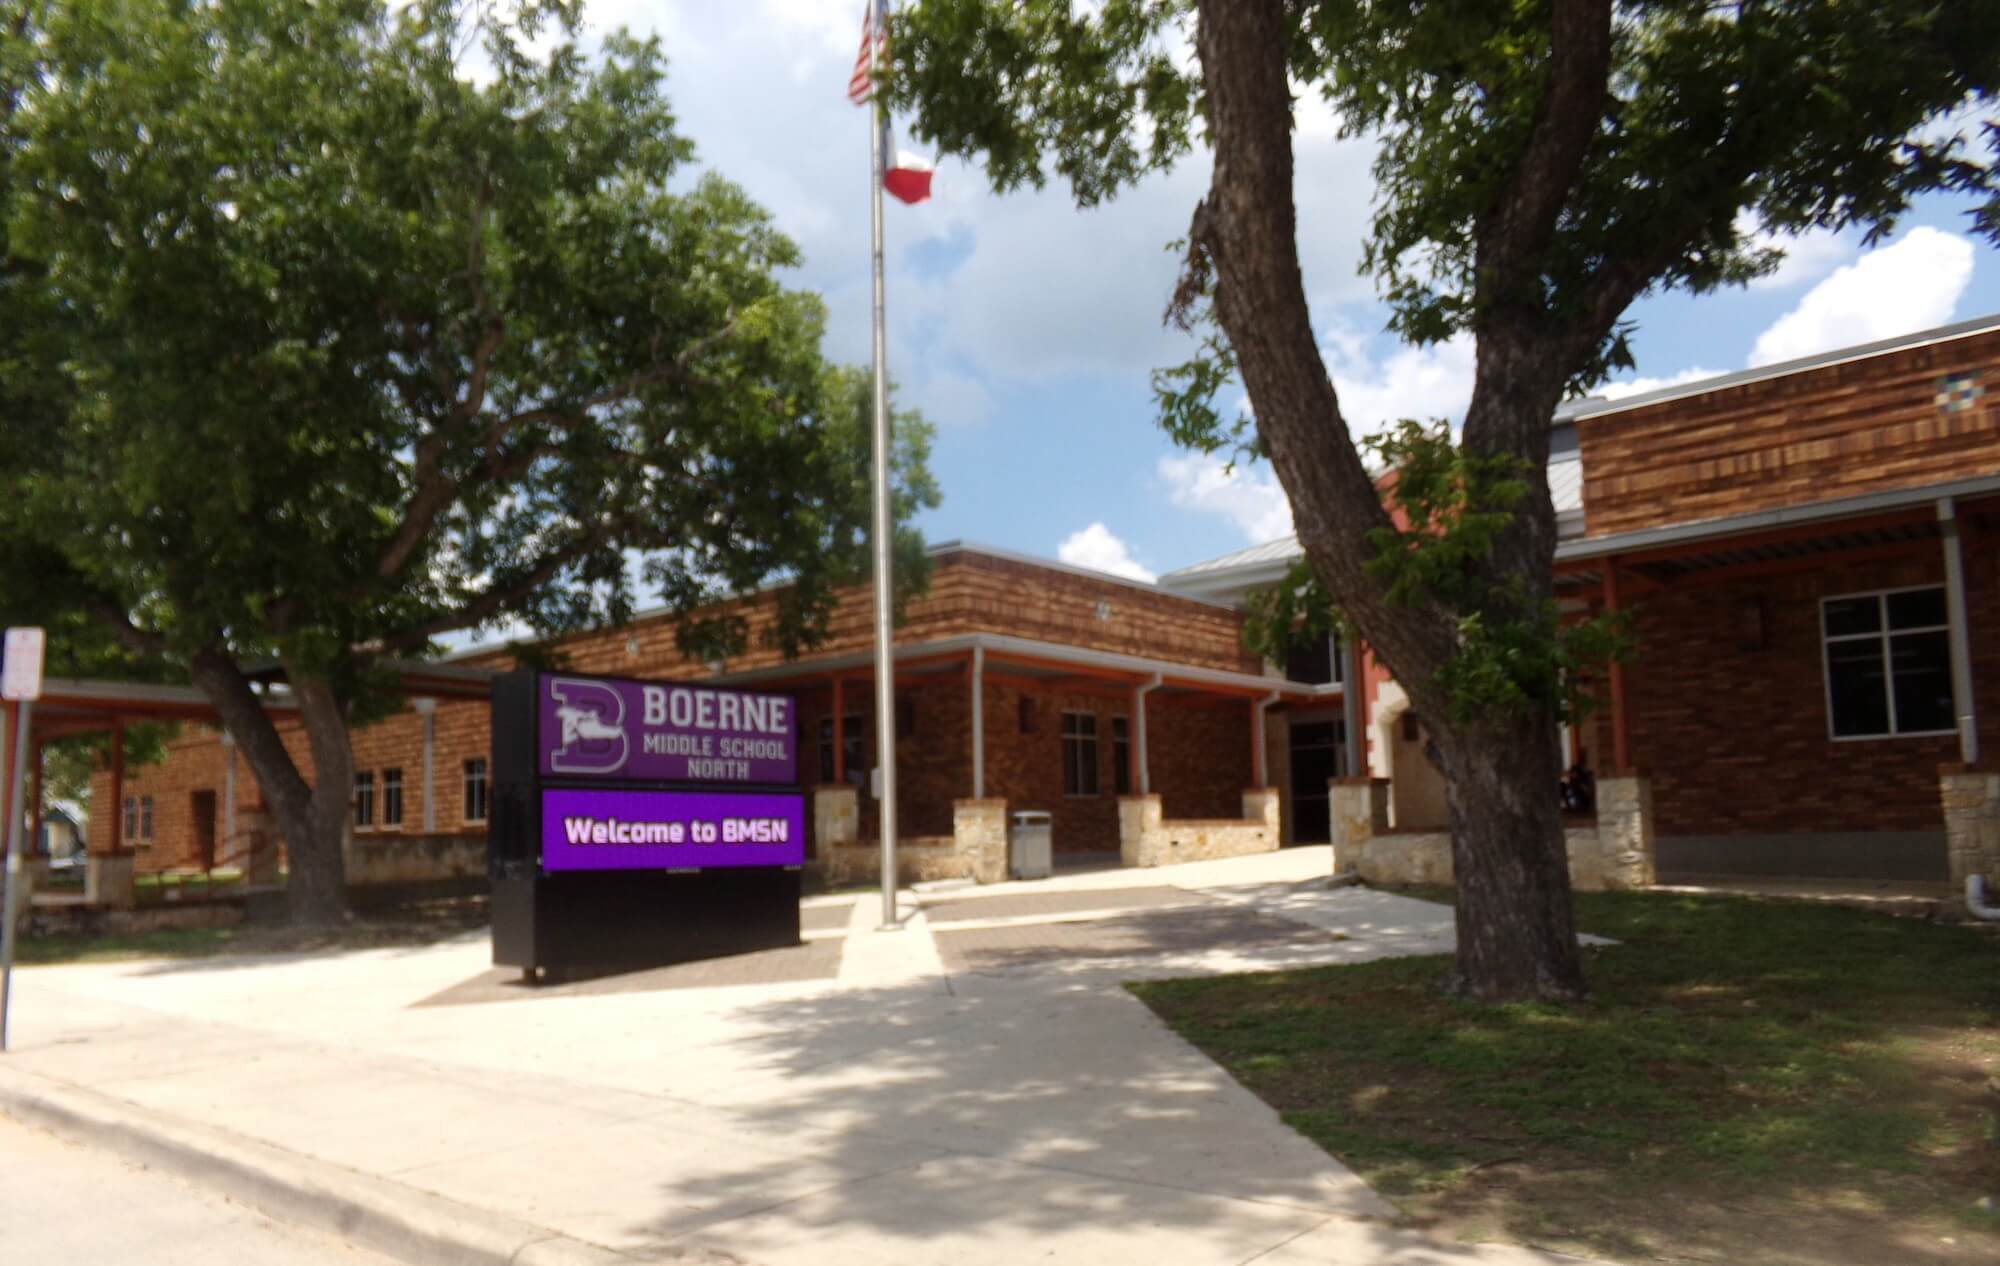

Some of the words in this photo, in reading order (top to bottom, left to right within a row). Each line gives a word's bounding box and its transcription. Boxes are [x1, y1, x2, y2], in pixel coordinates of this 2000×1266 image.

[642, 686, 788, 734] BOERNE
[643, 734, 712, 757] MIDDLE
[719, 739, 788, 760] SCHOOL
[687, 758, 750, 779] NORTH
[564, 817, 685, 844] Welcome
[690, 820, 717, 843] to
[722, 819, 788, 843] BMSN
